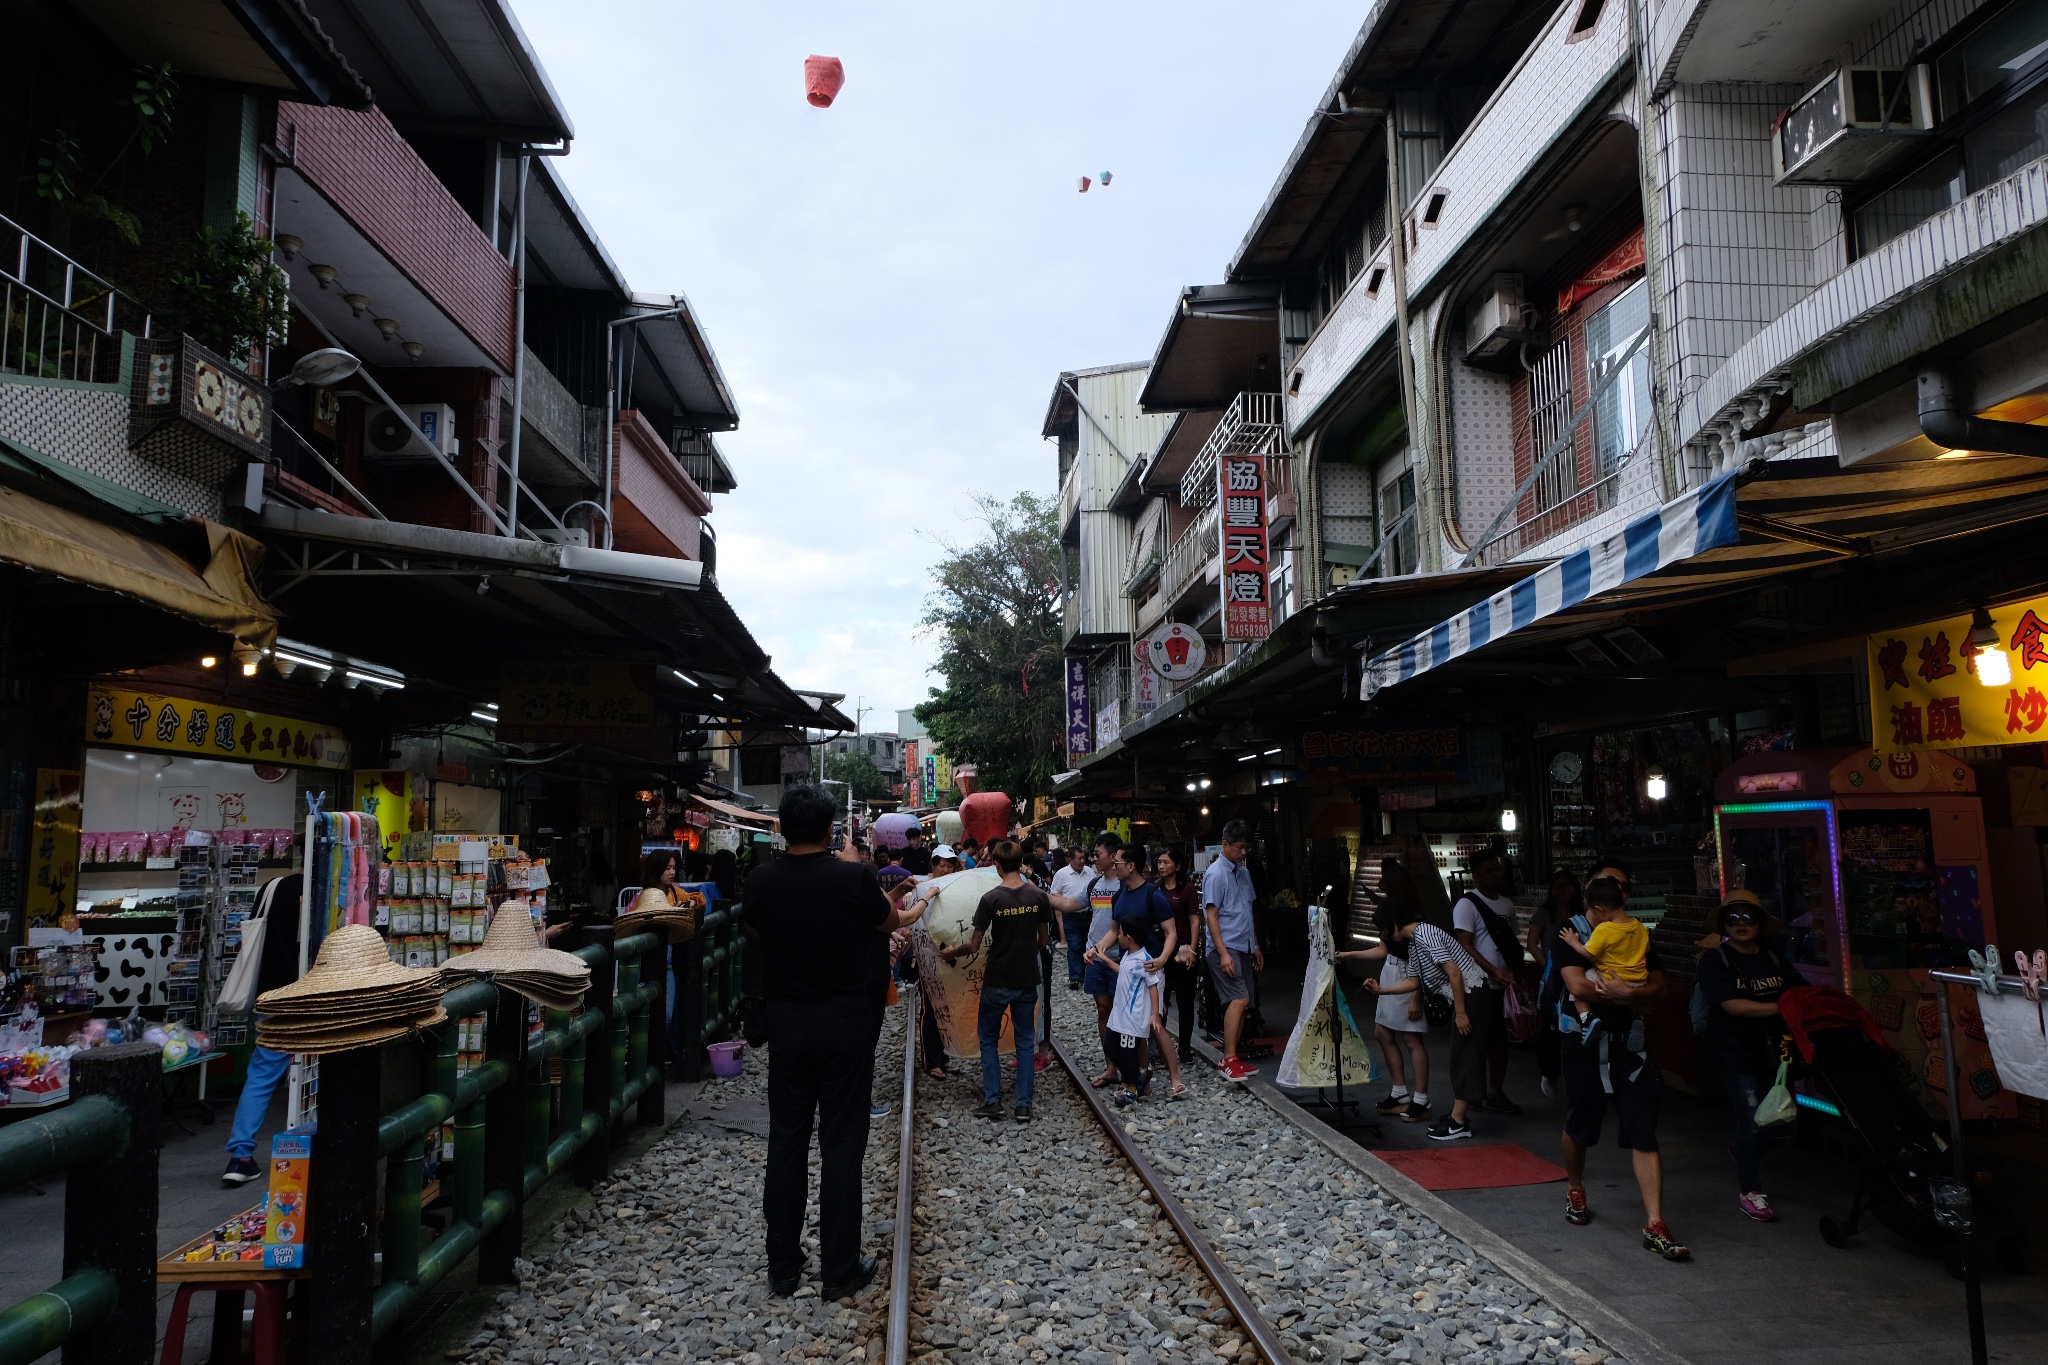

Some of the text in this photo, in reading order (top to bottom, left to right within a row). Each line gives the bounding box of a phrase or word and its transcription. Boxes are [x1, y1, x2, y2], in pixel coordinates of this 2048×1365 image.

[1224, 460, 1264, 604] 協豐天燈
[1228, 605, 1267, 623] 批發零售
[1230, 623, 1269, 637] 24958209
[1877, 608, 2048, 692] 寶桂食
[125, 697, 236, 752] 十分好運
[1070, 661, 1090, 752] 吉祥天燈
[1889, 695, 1967, 747] 油飯
[1301, 727, 1461, 758] 曾家花布天燈
[273, 1246, 294, 1257] Bath
[274, 1254, 293, 1266] Fun
